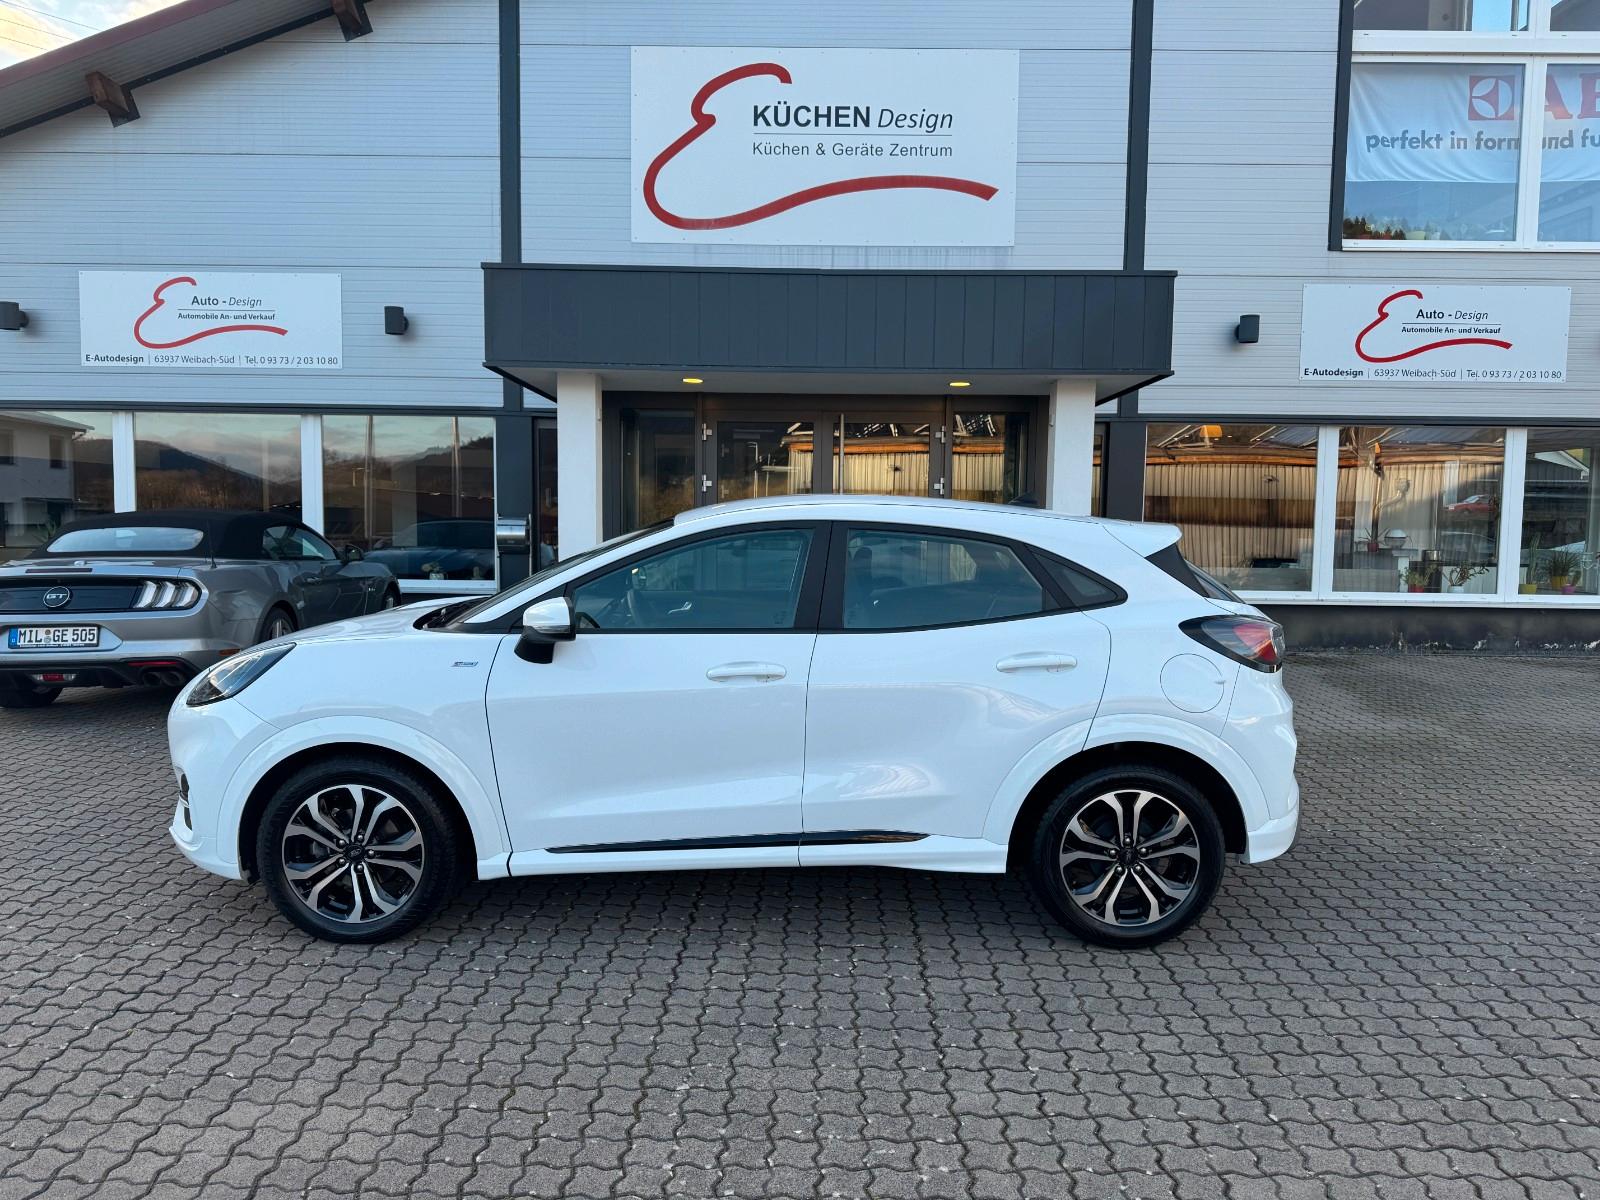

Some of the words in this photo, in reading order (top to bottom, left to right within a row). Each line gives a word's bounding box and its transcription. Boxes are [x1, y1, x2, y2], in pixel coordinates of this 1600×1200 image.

[753, 101, 870, 128] KÜCHEN
[878, 107, 954, 133] Design
[1366, 129, 1443, 152] perfekt
[1450, 130, 1468, 150] in
[753, 141, 810, 157] Küchen
[815, 142, 826, 157] &
[832, 142, 884, 157] Geräte
[889, 143, 953, 158] Zentrum
[191, 295, 219, 306] Auto
[228, 296, 262, 308] Design
[177, 312, 219, 320] Automobile
[248, 313, 275, 321] Verkauf
[1416, 308, 1445, 319] Auto
[1454, 310, 1489, 322] Design
[1401, 326, 1443, 334] Automobile
[1444, 326, 1457, 334] An-
[85, 354, 144, 364] E-Autodesign
[154, 355, 180, 363] 63937
[181, 355, 235, 364] Weibach-Süd
[1304, 368, 1364, 378] E-Autodesign
[1374, 369, 1400, 377] 63937
[1401, 368, 1457, 378] Weibach-Süd
[18, 629, 43, 643] MIL
[52, 628, 69, 643] GE
[71, 628, 96, 642] 505
